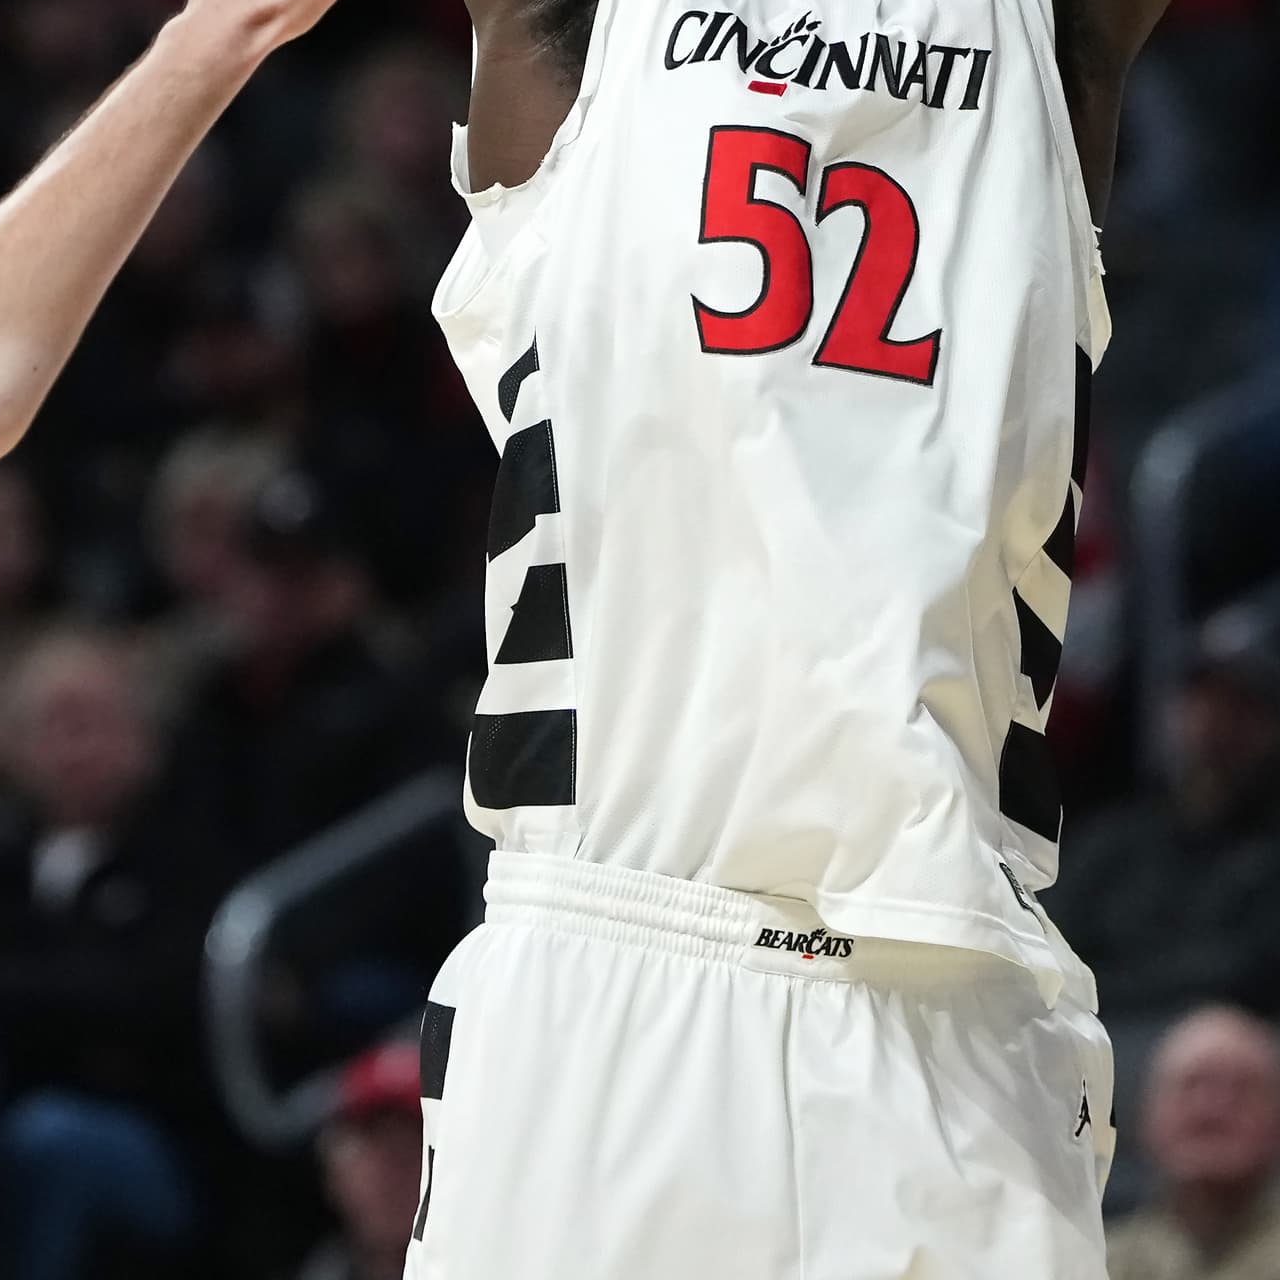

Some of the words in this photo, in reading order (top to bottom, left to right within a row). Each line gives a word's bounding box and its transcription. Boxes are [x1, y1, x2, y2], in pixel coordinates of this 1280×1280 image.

[664, 10, 992, 111] CINCINNATI
[691, 124, 943, 387] 52
[754, 928, 854, 960] BEARCATS
